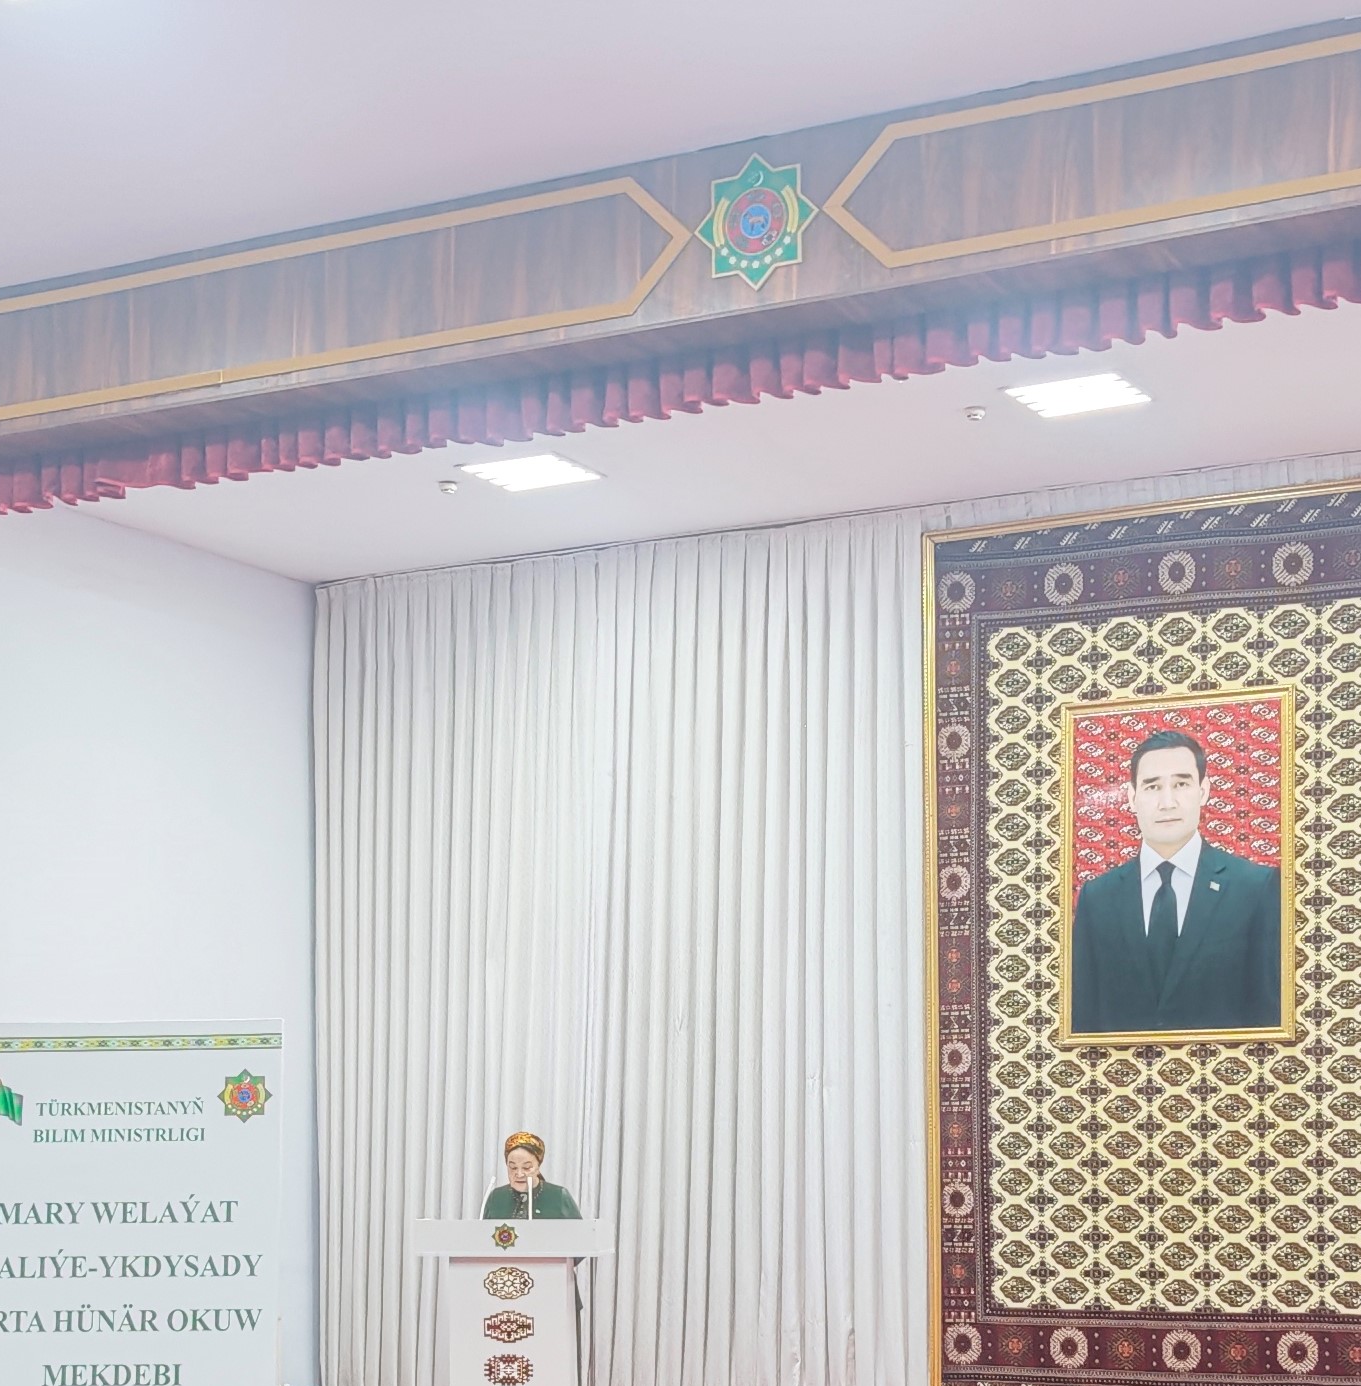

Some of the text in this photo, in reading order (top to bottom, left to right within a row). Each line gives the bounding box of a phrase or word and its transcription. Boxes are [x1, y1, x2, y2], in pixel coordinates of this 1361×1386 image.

[36, 1096, 204, 1117] TÜRKMENISTANYŇ
[33, 1127, 206, 1143] BILIM MINISTRLIGI
[91, 1194, 239, 1225] WELAÝAT
[52, 1304, 159, 1333] HÜNÄR
[166, 1308, 263, 1332] OKUW
